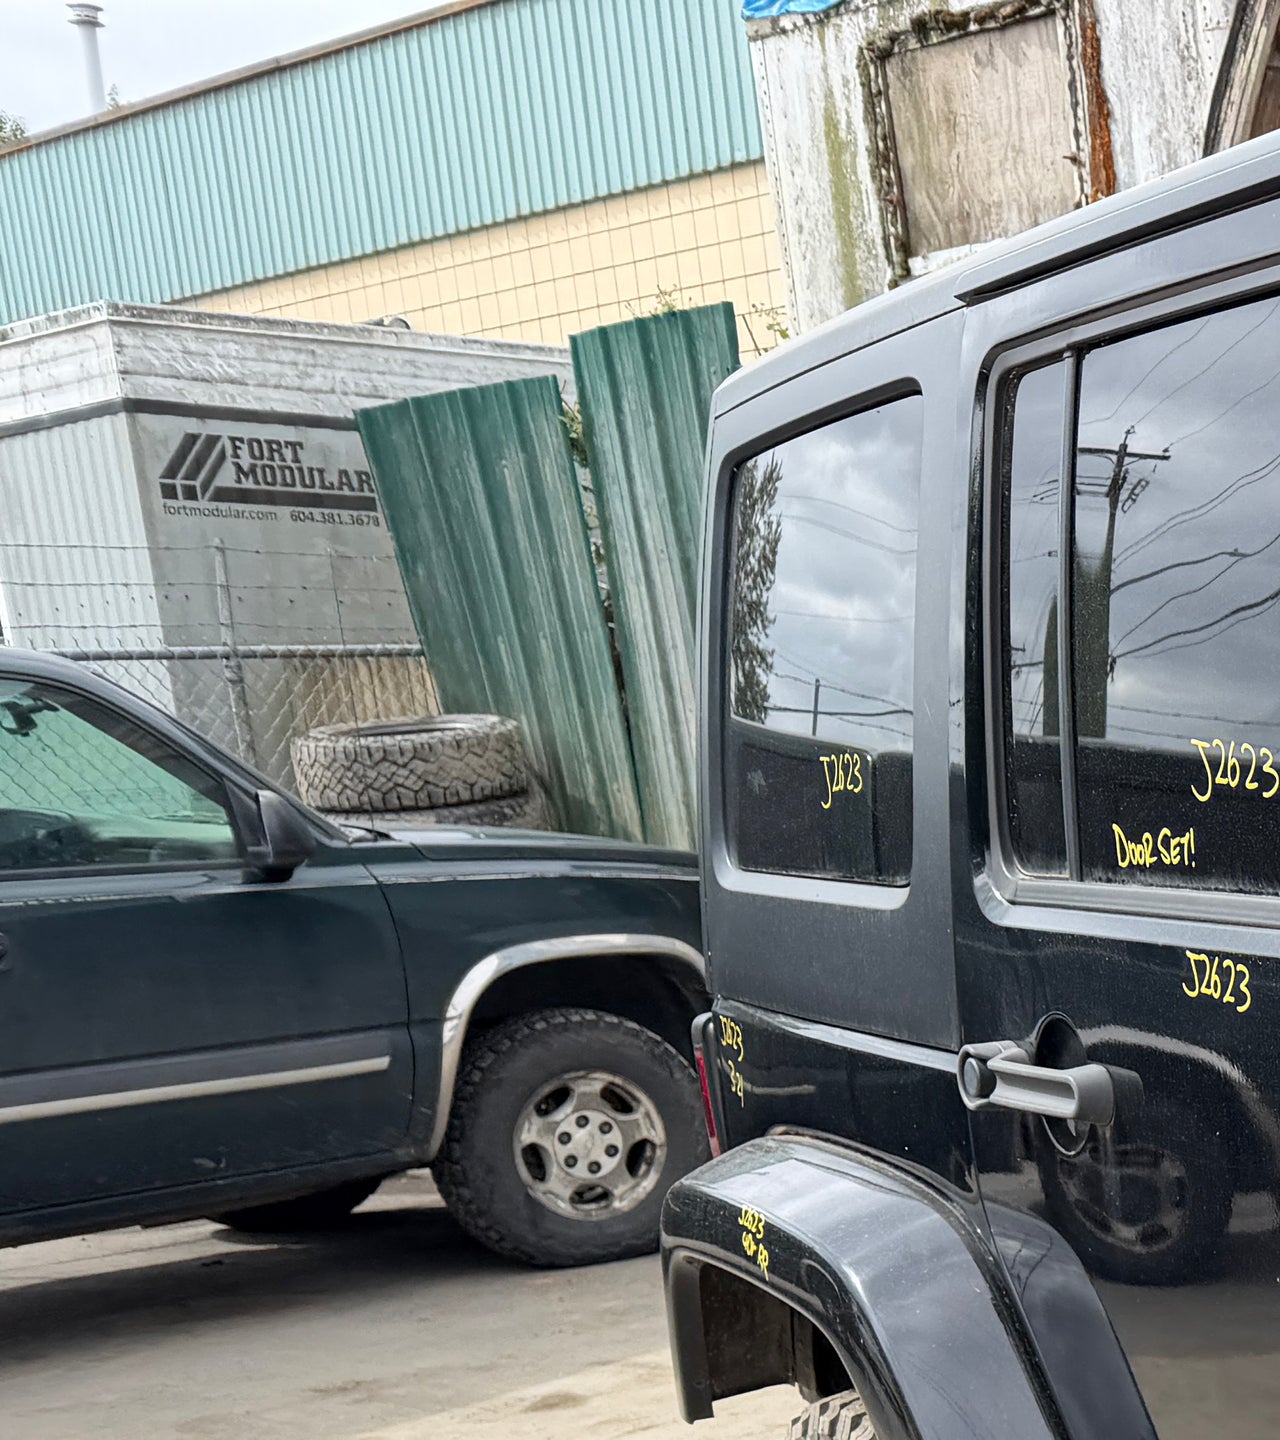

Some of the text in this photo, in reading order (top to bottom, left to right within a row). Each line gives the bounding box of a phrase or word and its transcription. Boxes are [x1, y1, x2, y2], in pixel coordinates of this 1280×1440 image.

[227, 435, 304, 464] FORT
[232, 460, 377, 494] MODULAR
[162, 502, 381, 528] fortmodular.com 604.381.3678
[819, 753, 863, 809] J2623
[1190, 739, 1279, 802] J2623
[1112, 823, 1196, 868] DOOR SET!
[1182, 950, 1251, 1012] J2623
[720, 1015, 744, 1062] J2623
